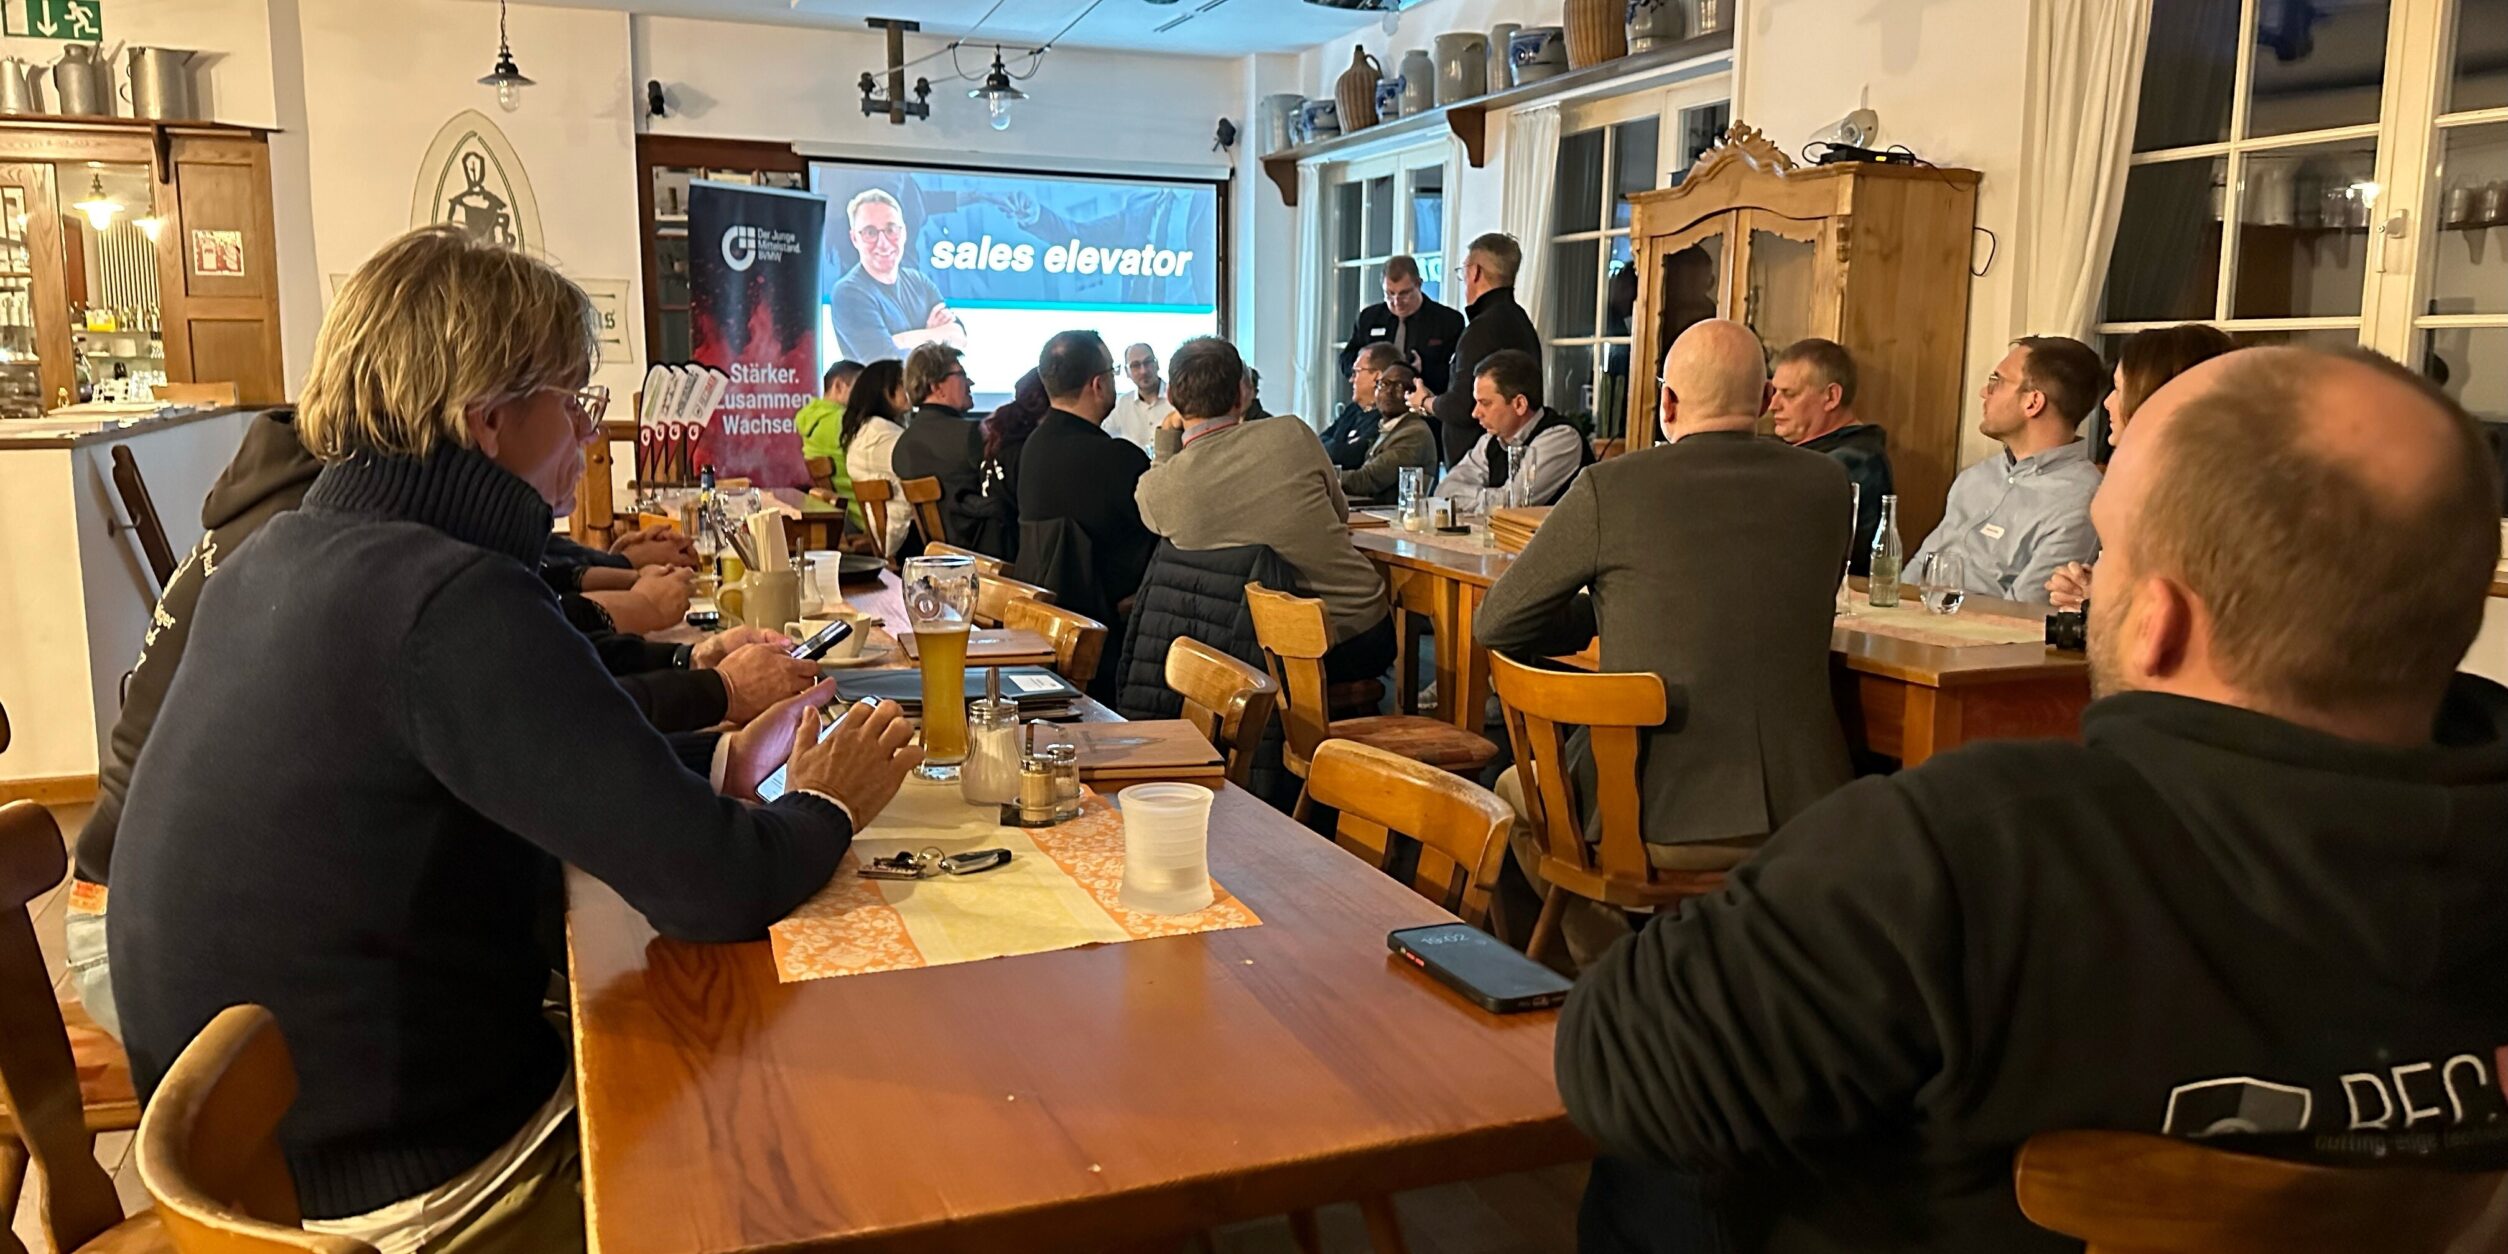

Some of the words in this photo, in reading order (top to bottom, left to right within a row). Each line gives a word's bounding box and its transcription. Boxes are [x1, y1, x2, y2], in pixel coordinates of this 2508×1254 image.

[757, 227, 771, 240] Der
[771, 230, 796, 244] Junge
[930, 235, 1035, 273] sales
[1043, 239, 1193, 277] elevator
[730, 362, 800, 384] Stärker.
[722, 413, 797, 435] Wachse
